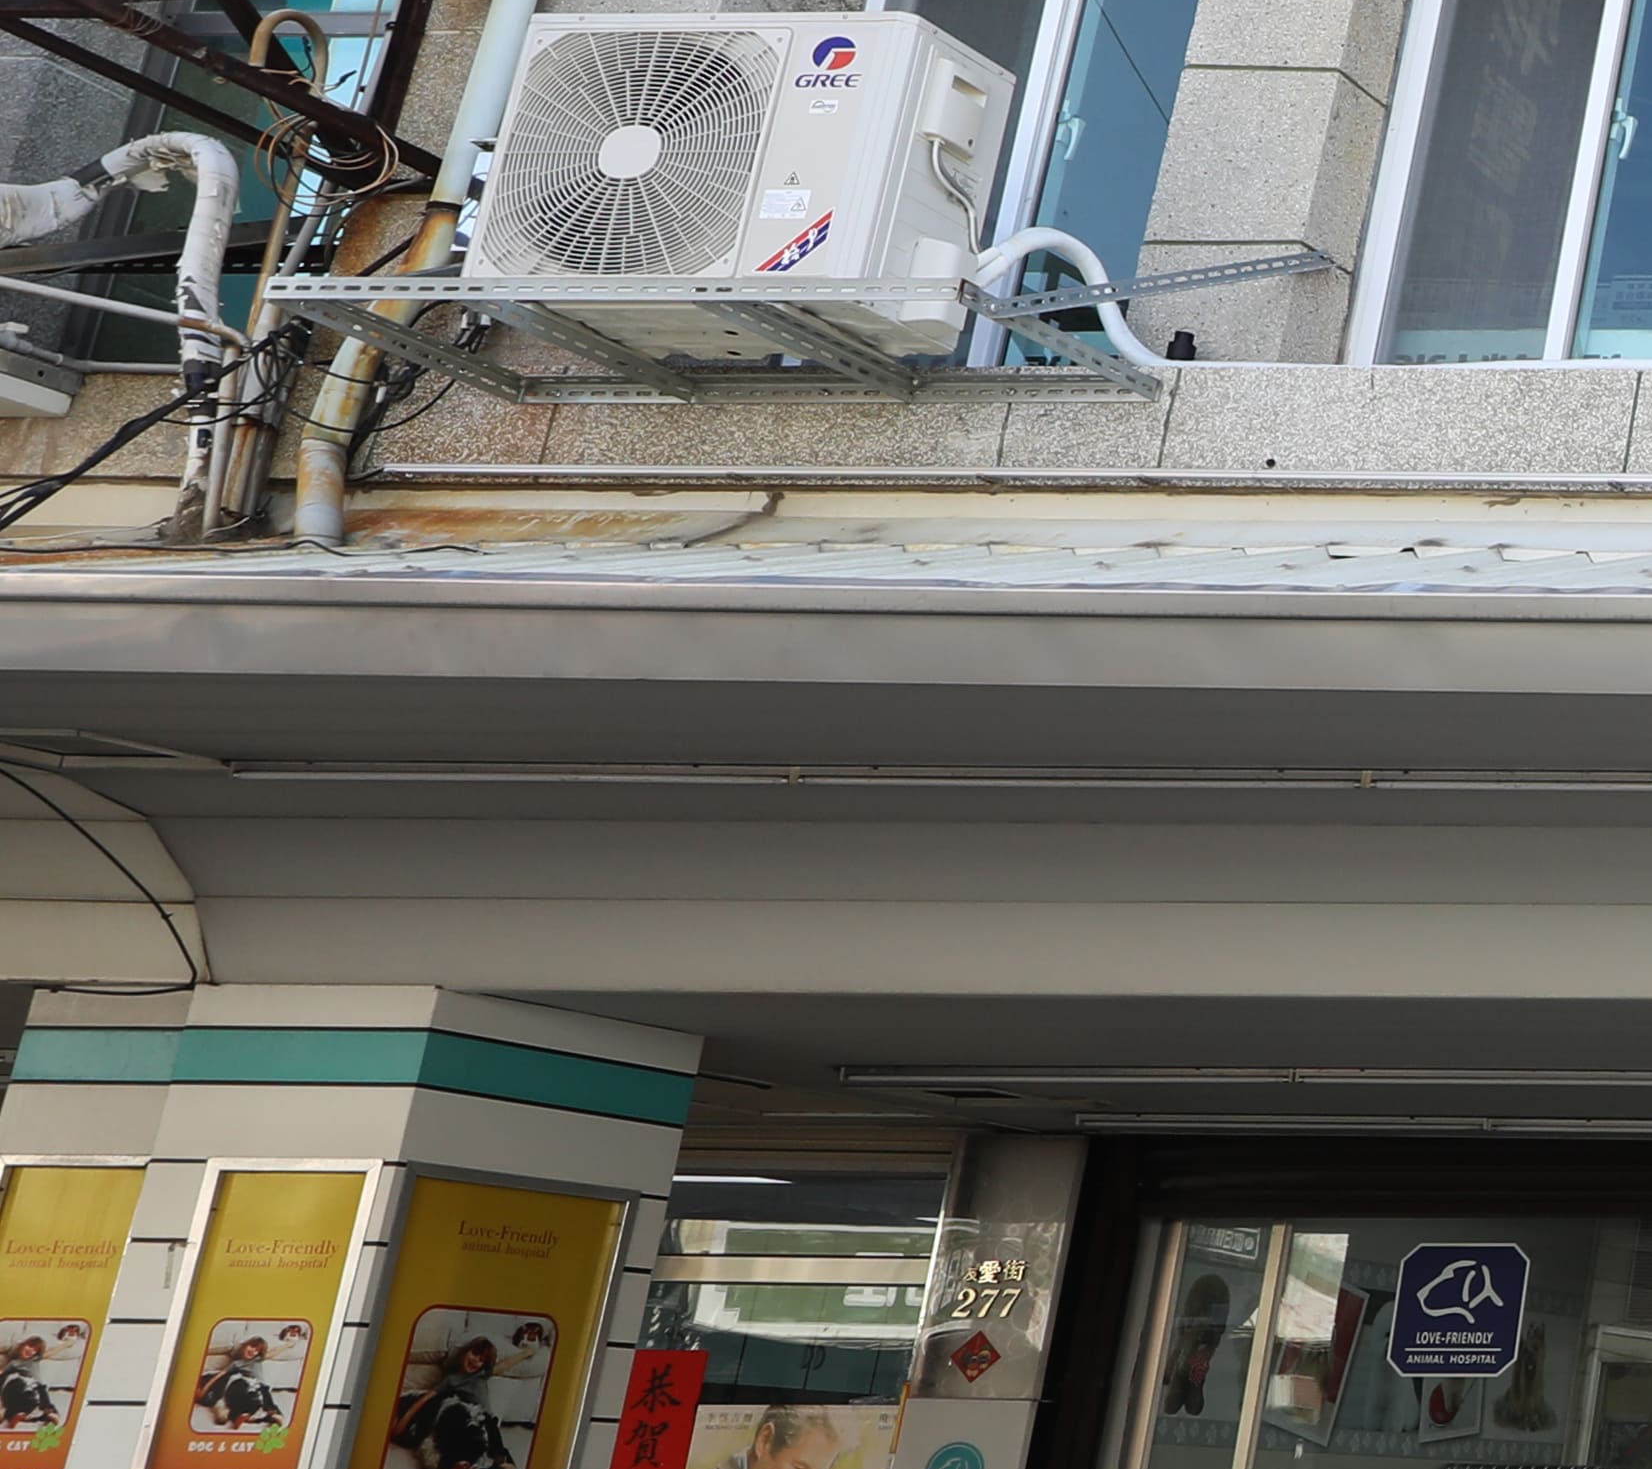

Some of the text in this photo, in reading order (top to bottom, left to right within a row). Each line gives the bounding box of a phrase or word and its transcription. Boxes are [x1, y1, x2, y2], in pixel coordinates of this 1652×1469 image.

[795, 73, 862, 88] GREE
[459, 1219, 560, 1248] Love-Friendly
[5, 1239, 118, 1257] Love-Friendly
[226, 1238, 340, 1257] Love-Friendly
[278, 1257, 328, 1270] hospital
[964, 1260, 1027, 1286] 友愛街
[951, 1287, 1023, 1319] 277
[1416, 1331, 1494, 1344] LOVE-FRIENDLY
[1406, 1355, 1497, 1365] ANIMAL HOSPITAL
[188, 1441, 213, 1453] DOG
[229, 1441, 255, 1453] CAT
